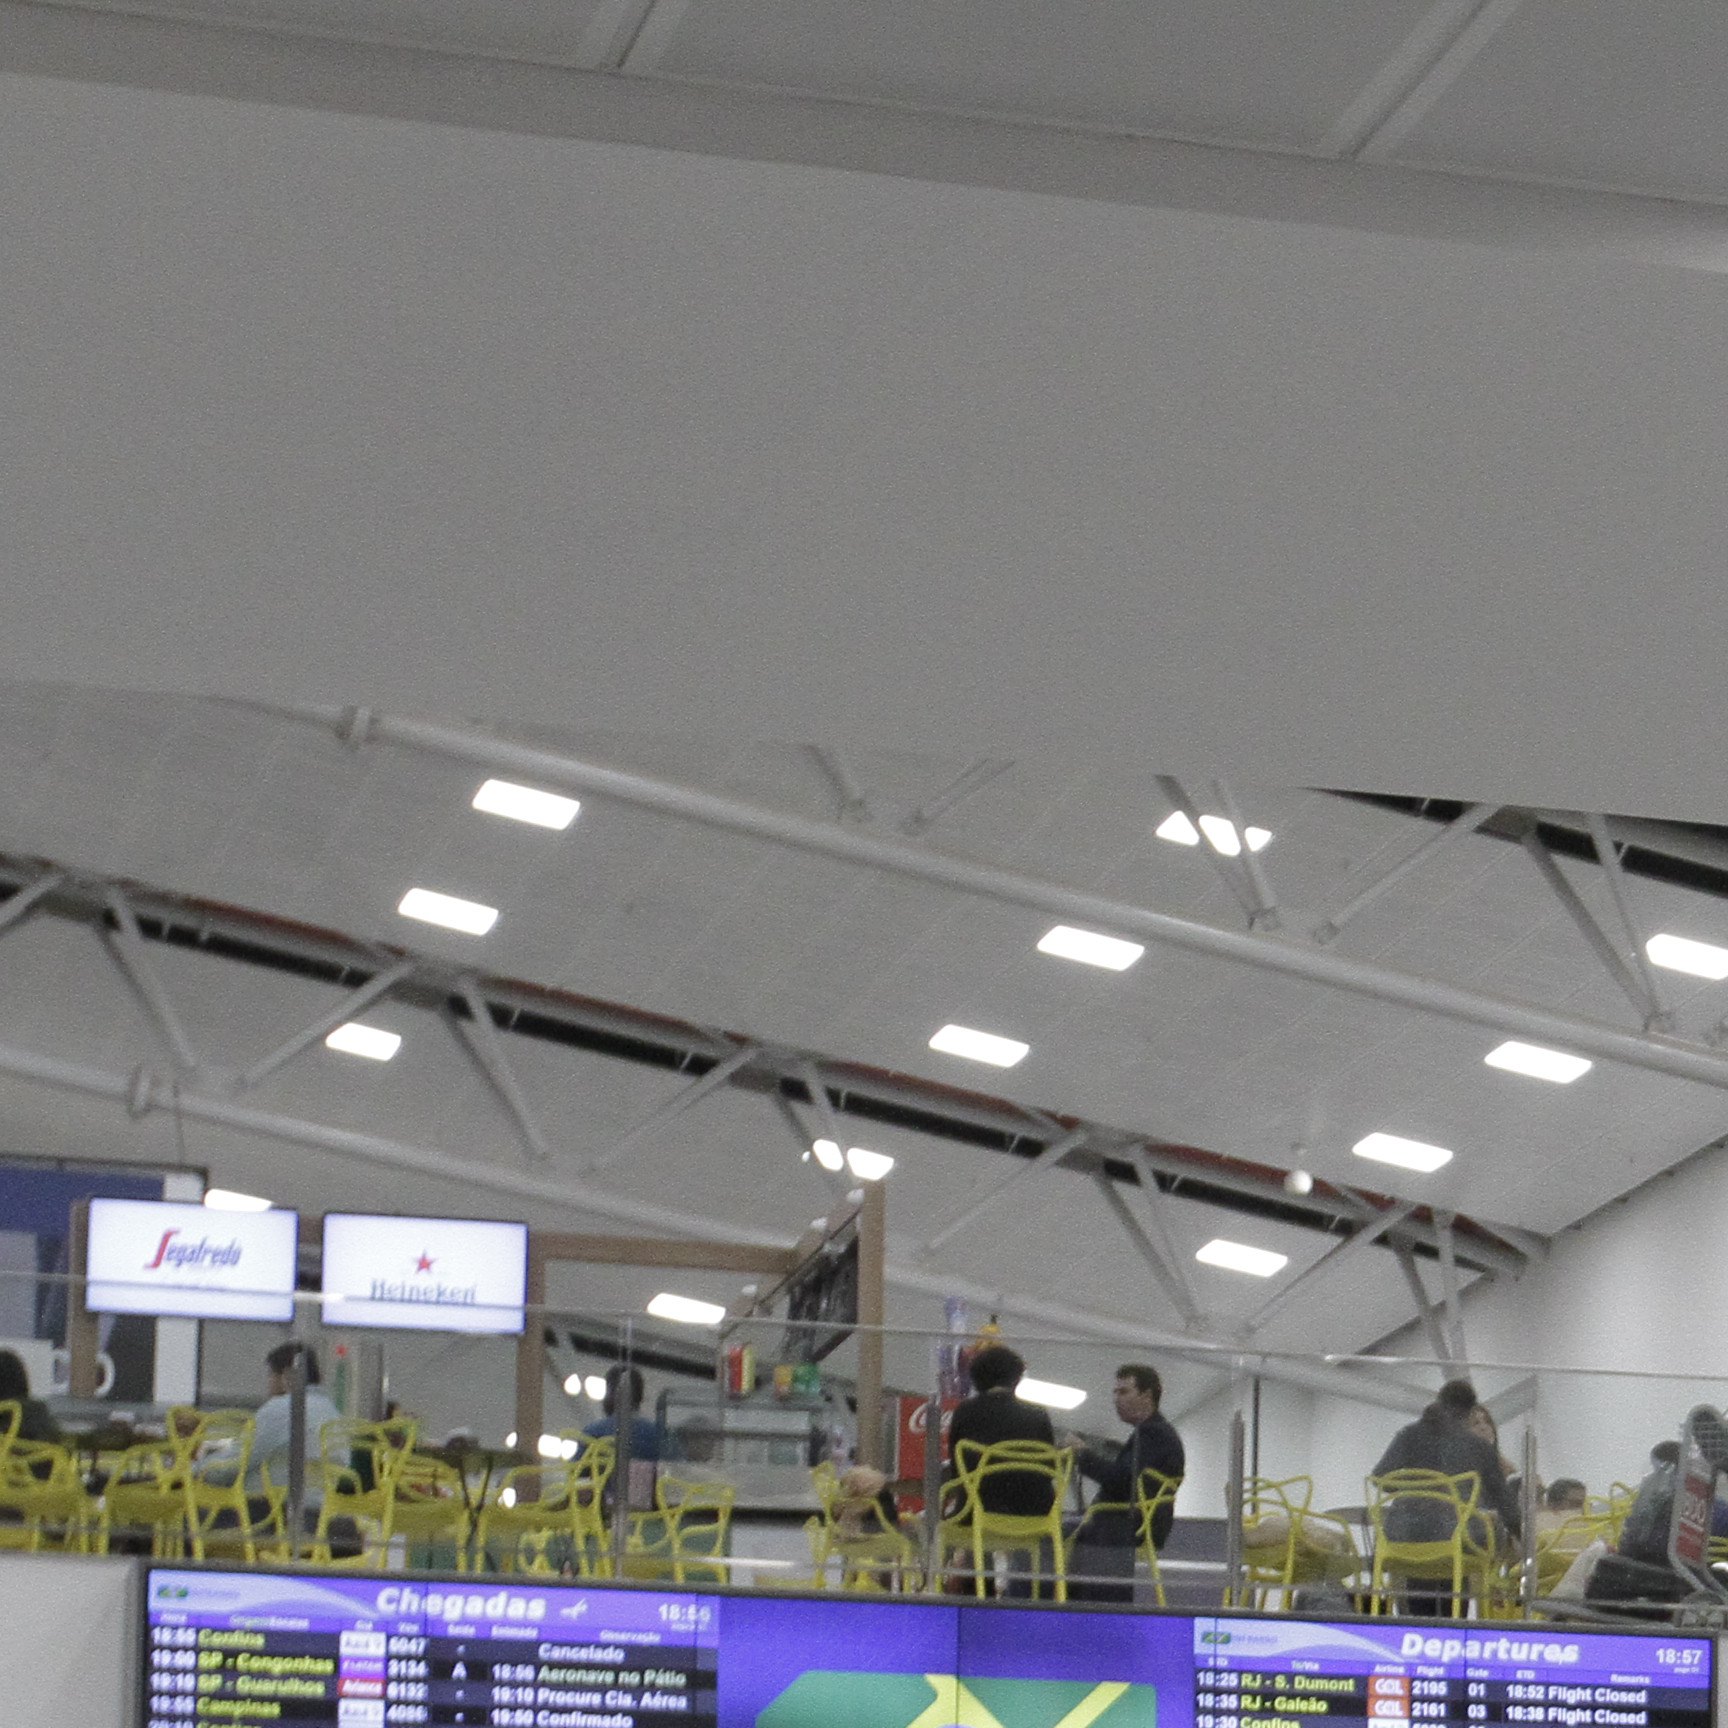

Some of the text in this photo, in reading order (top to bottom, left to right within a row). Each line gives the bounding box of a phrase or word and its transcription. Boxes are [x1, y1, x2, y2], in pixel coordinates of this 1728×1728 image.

[377, 1586, 547, 1622] Chegadas
[538, 1642, 626, 1664] Cancelado
[1400, 1632, 1580, 1664] Departures
[1656, 1648, 1702, 1666] 18:57
[538, 1665, 615, 1685] Aeronave
[1197, 1671, 1648, 1704] 18:25 Dumont 2195 01 18:52 Flight Closed
[537, 1687, 602, 1708] Procure
[1197, 1693, 1238, 1709] 18:35
[1274, 1697, 1328, 1714] Galeão
[1412, 1702, 1447, 1718] 2161
[1548, 1707, 1591, 1726] Flight
[1594, 1708, 1648, 1725] Closed
